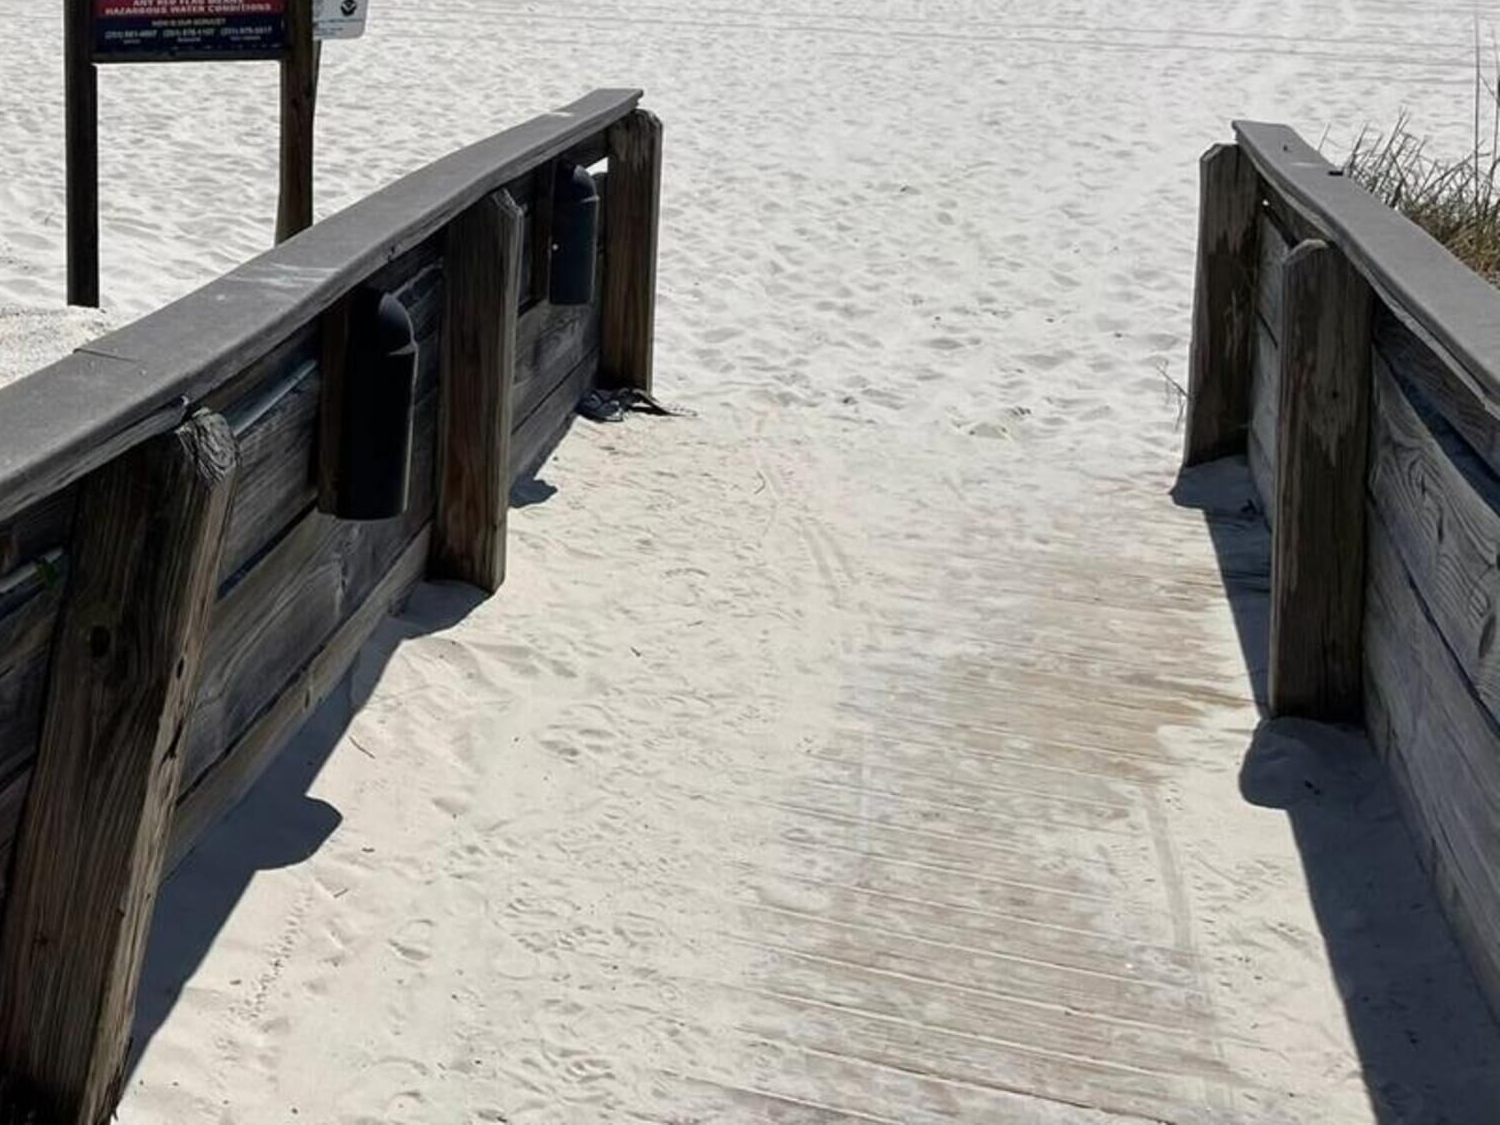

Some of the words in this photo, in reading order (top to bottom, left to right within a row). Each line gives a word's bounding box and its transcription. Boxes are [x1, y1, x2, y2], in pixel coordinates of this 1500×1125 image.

[105, 6, 167, 15] HAZARDOUS
[170, 5, 205, 13] WATER
[207, 3, 271, 13] CONDITIONS
